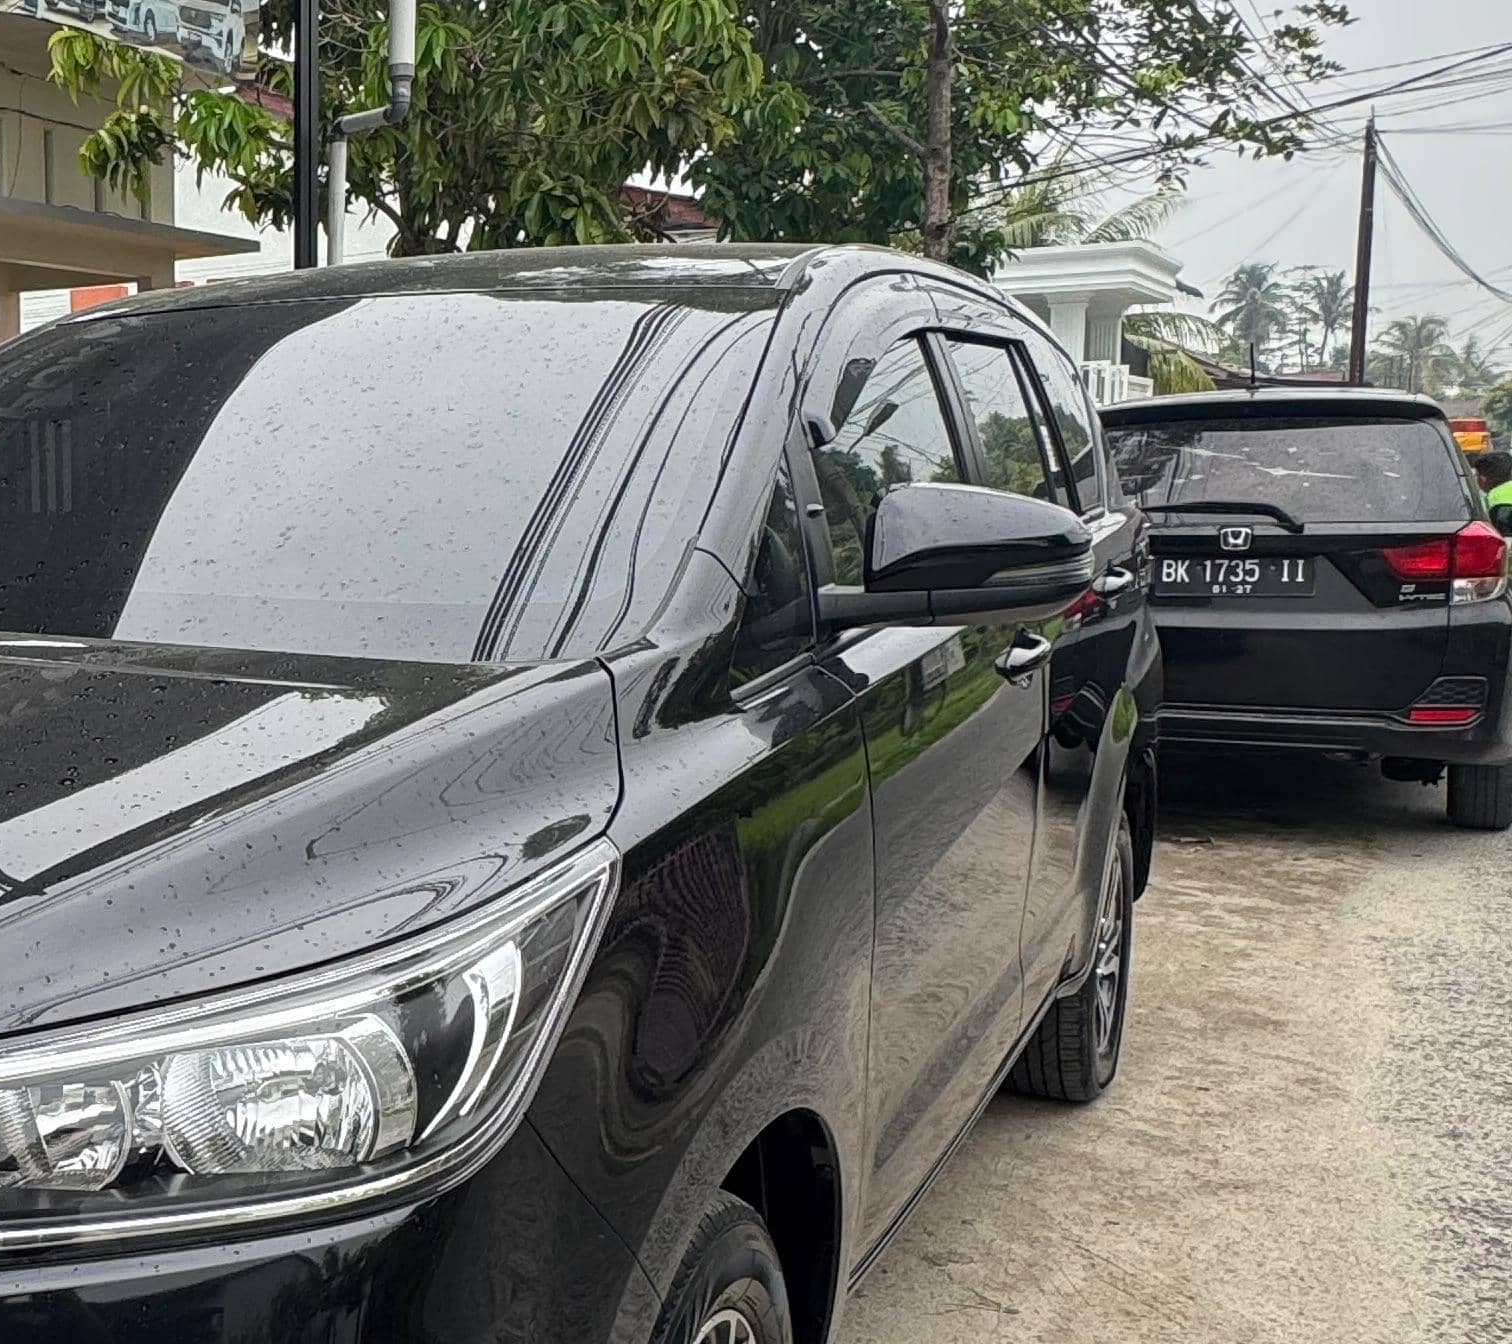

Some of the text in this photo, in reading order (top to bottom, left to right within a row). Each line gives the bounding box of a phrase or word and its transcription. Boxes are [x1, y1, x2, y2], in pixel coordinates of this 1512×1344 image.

[1161, 559, 1305, 583] BK 1735 II
